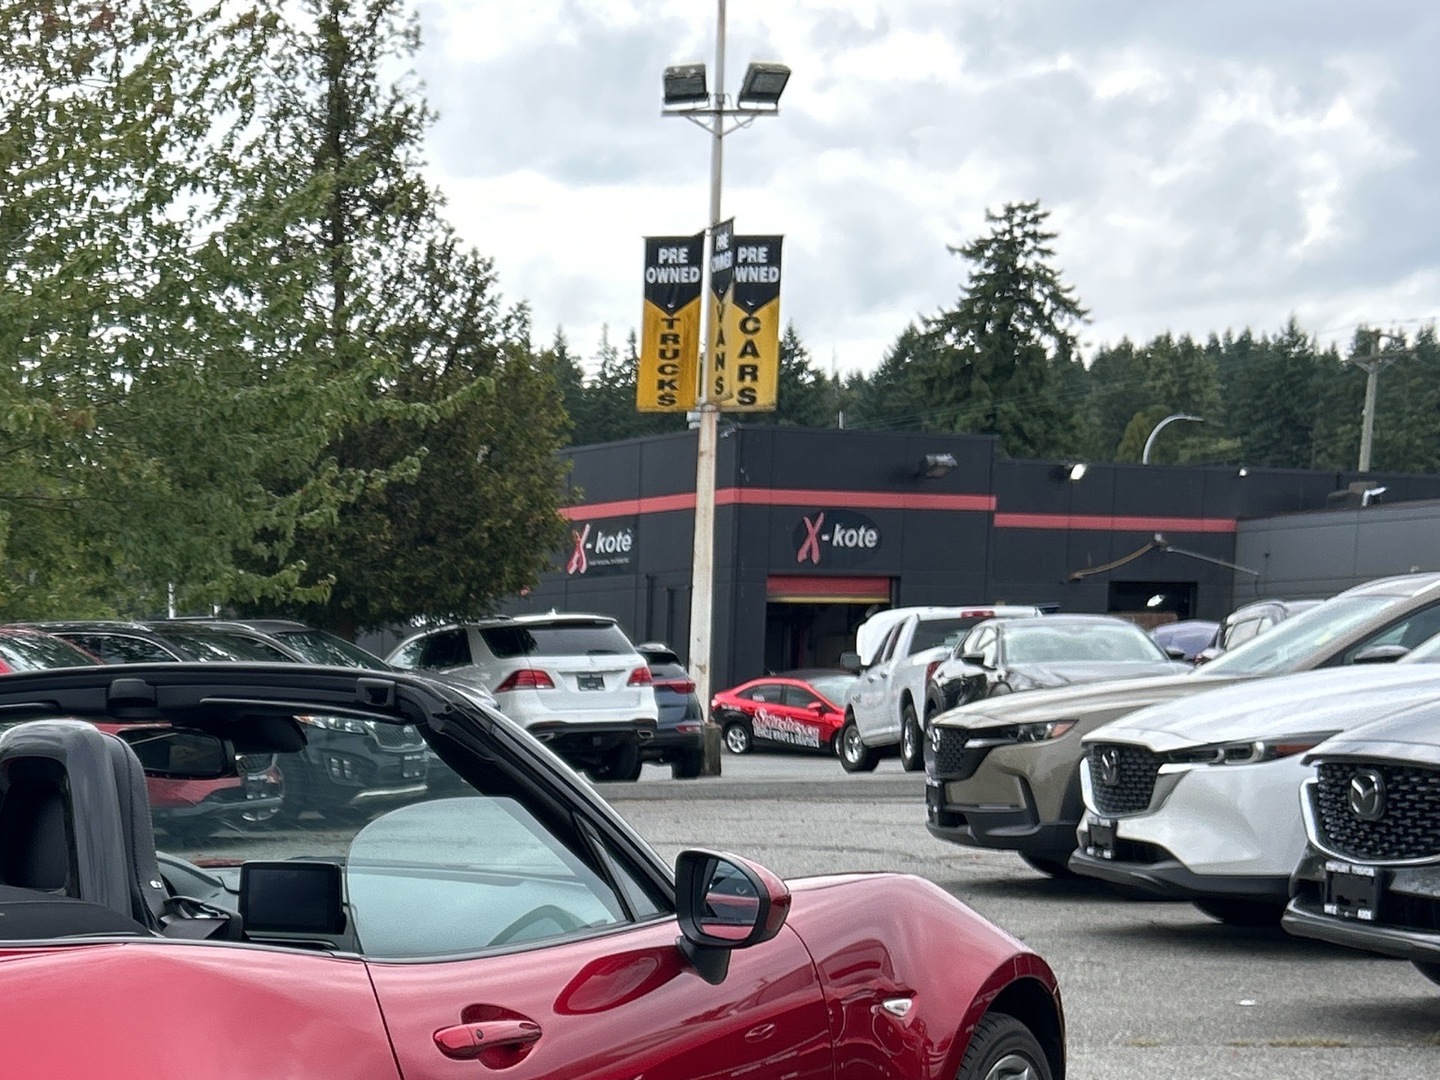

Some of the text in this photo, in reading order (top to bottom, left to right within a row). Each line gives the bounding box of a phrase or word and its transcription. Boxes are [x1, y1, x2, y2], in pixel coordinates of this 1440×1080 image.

[658, 246, 689, 264] PRE
[737, 246, 768, 264] PRE
[645, 266, 700, 284] OWNED
[734, 265, 780, 284] WNED
[657, 317, 681, 407] TRUCKS
[737, 316, 761, 406] CARS
